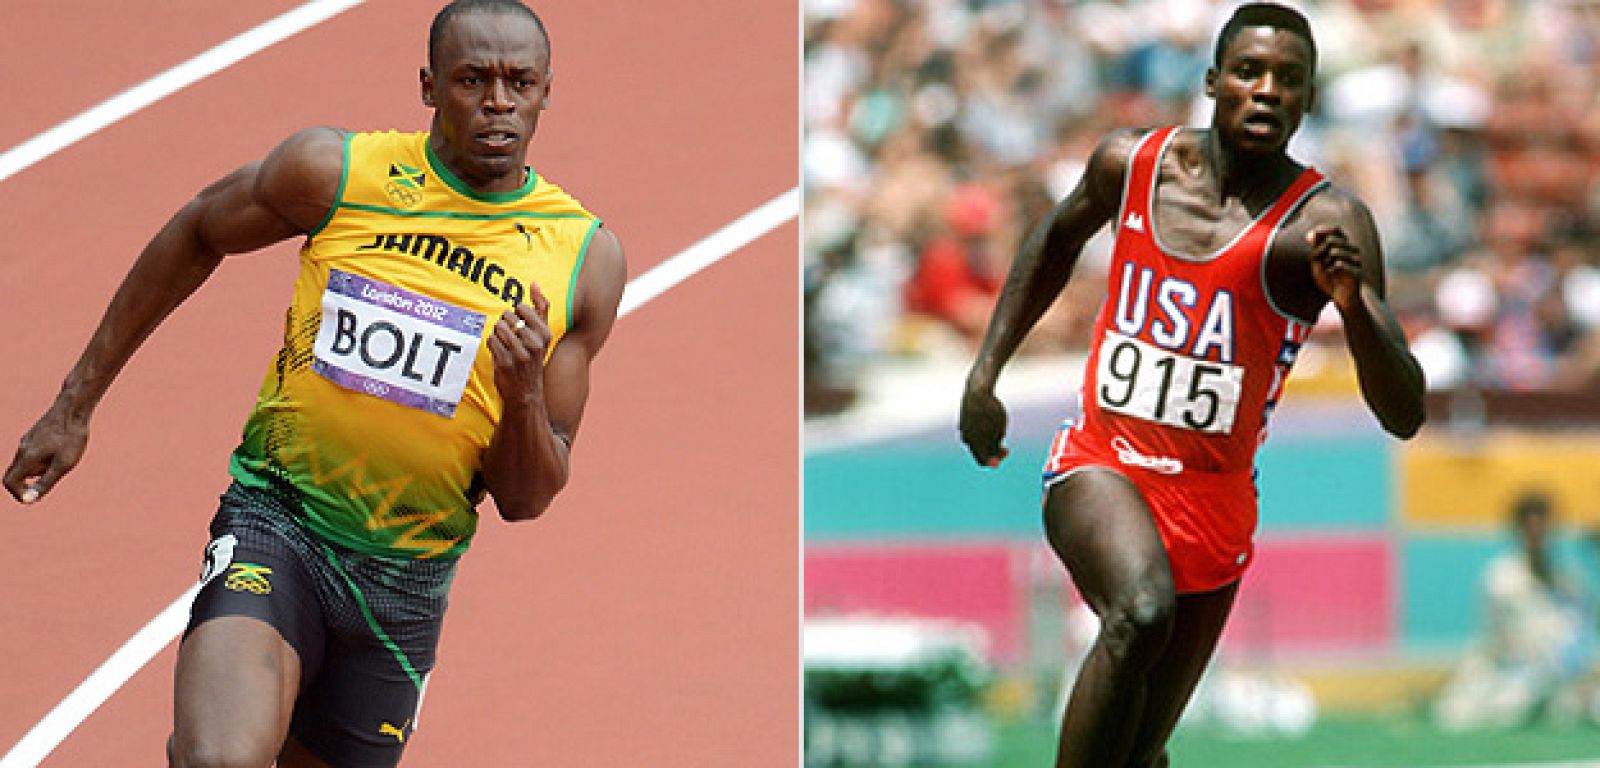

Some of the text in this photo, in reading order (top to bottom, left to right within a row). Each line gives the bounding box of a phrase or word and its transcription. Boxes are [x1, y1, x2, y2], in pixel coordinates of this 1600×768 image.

[355, 234, 523, 308] JAMAICA
[414, 299, 450, 321] 2012
[330, 307, 462, 387] BOLT
[1114, 262, 1234, 363] USA
[1100, 342, 1223, 429] 915
